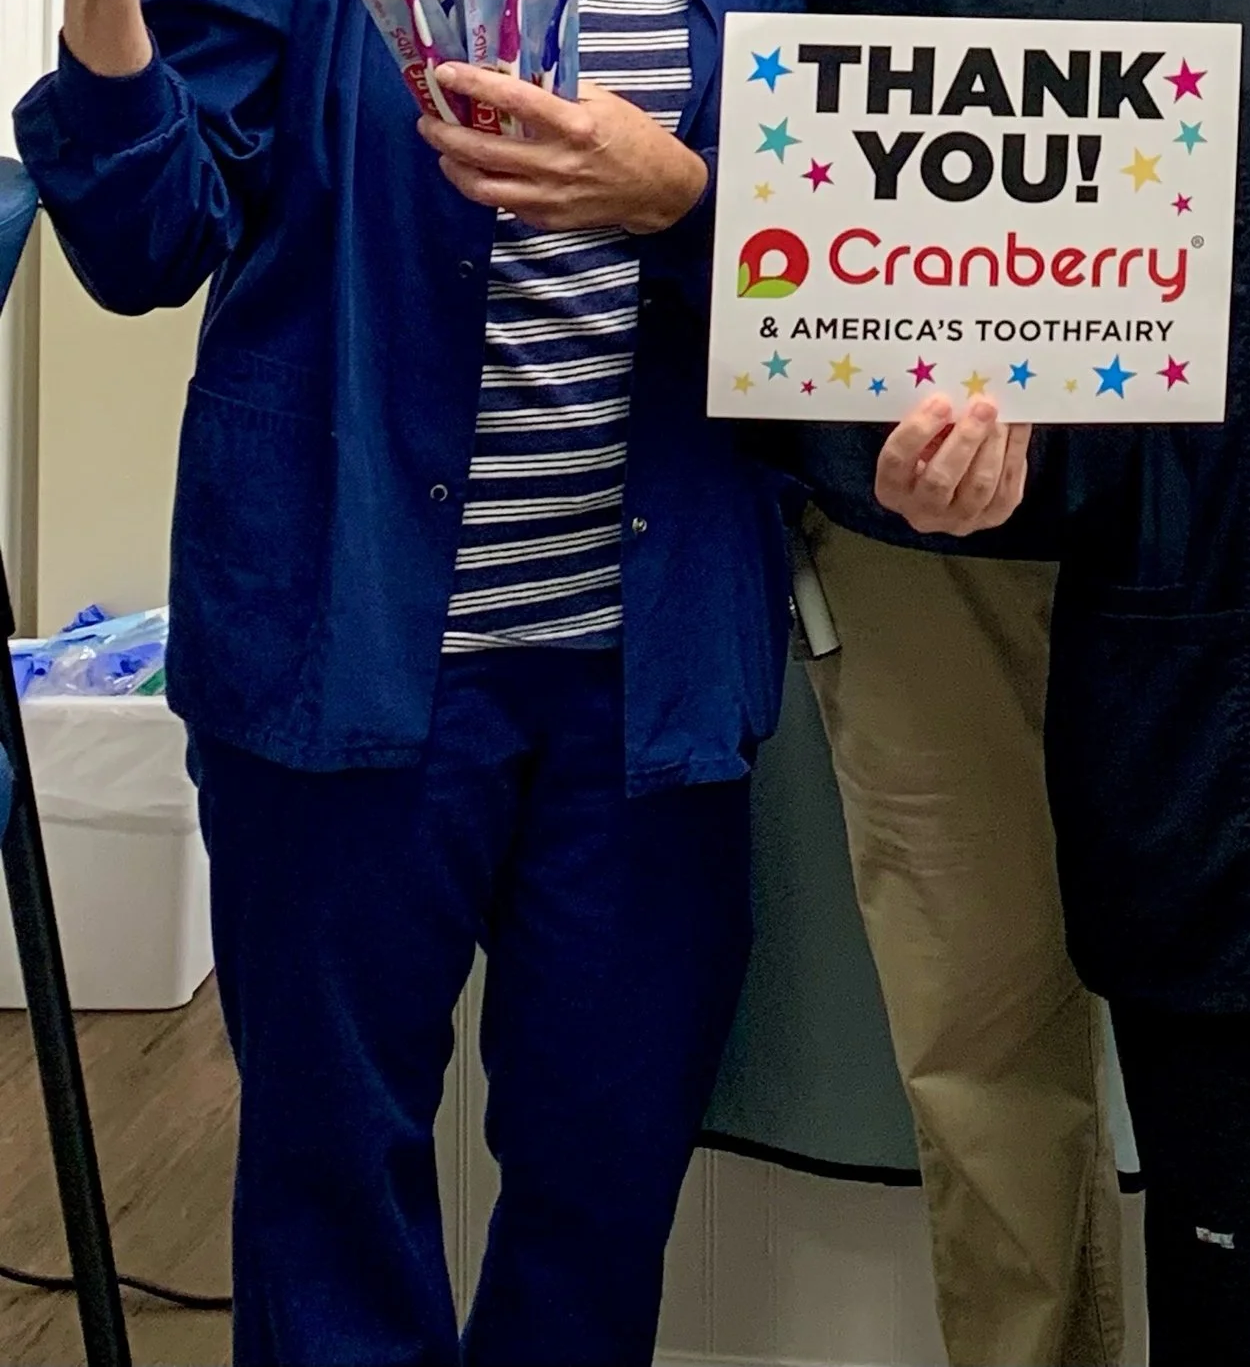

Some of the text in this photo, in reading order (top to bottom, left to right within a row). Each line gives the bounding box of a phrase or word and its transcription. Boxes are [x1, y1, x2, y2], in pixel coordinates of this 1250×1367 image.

[391, 27, 417, 60] KIDS
[472, 24, 489, 63] KIDS
[798, 43, 1167, 120] THANK
[852, 130, 1102, 204] YOU!
[759, 316, 1175, 342] & AMERICA’S TOOTHFAIRY
